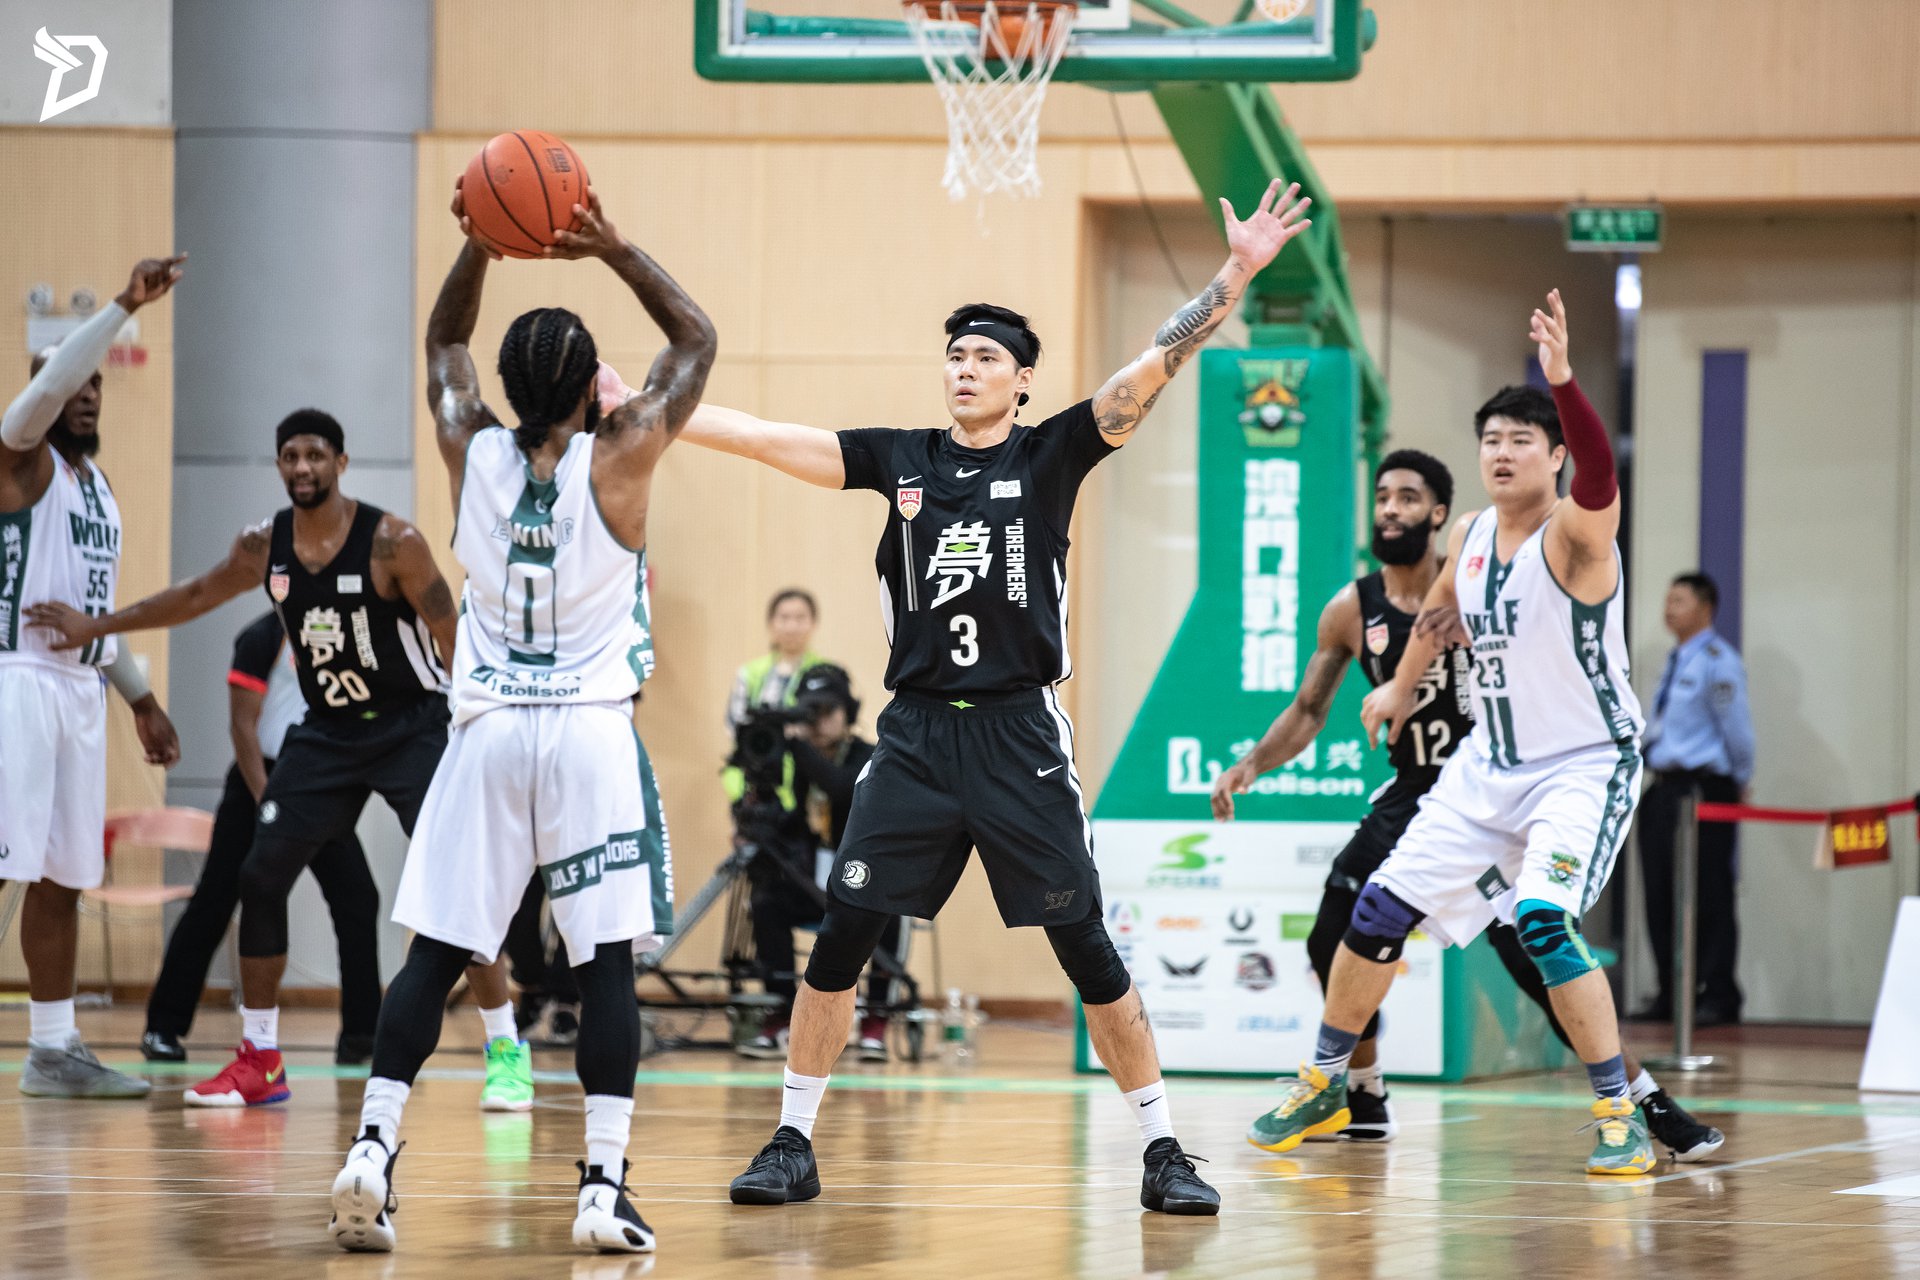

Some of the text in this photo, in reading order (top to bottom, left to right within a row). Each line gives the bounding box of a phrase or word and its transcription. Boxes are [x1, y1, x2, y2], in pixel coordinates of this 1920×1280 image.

[901, 492, 920, 502] ABL
[490, 513, 574, 548] EWING
[1005, 517, 1028, 608] "DREAMERS"
[86, 568, 109, 600] 55
[949, 614, 980, 667] 3
[317, 669, 372, 708] 20
[1475, 656, 1507, 690] 23
[500, 684, 581, 698] Bolison
[1410, 718, 1451, 767] 12
[1248, 774, 1366, 796] olison
